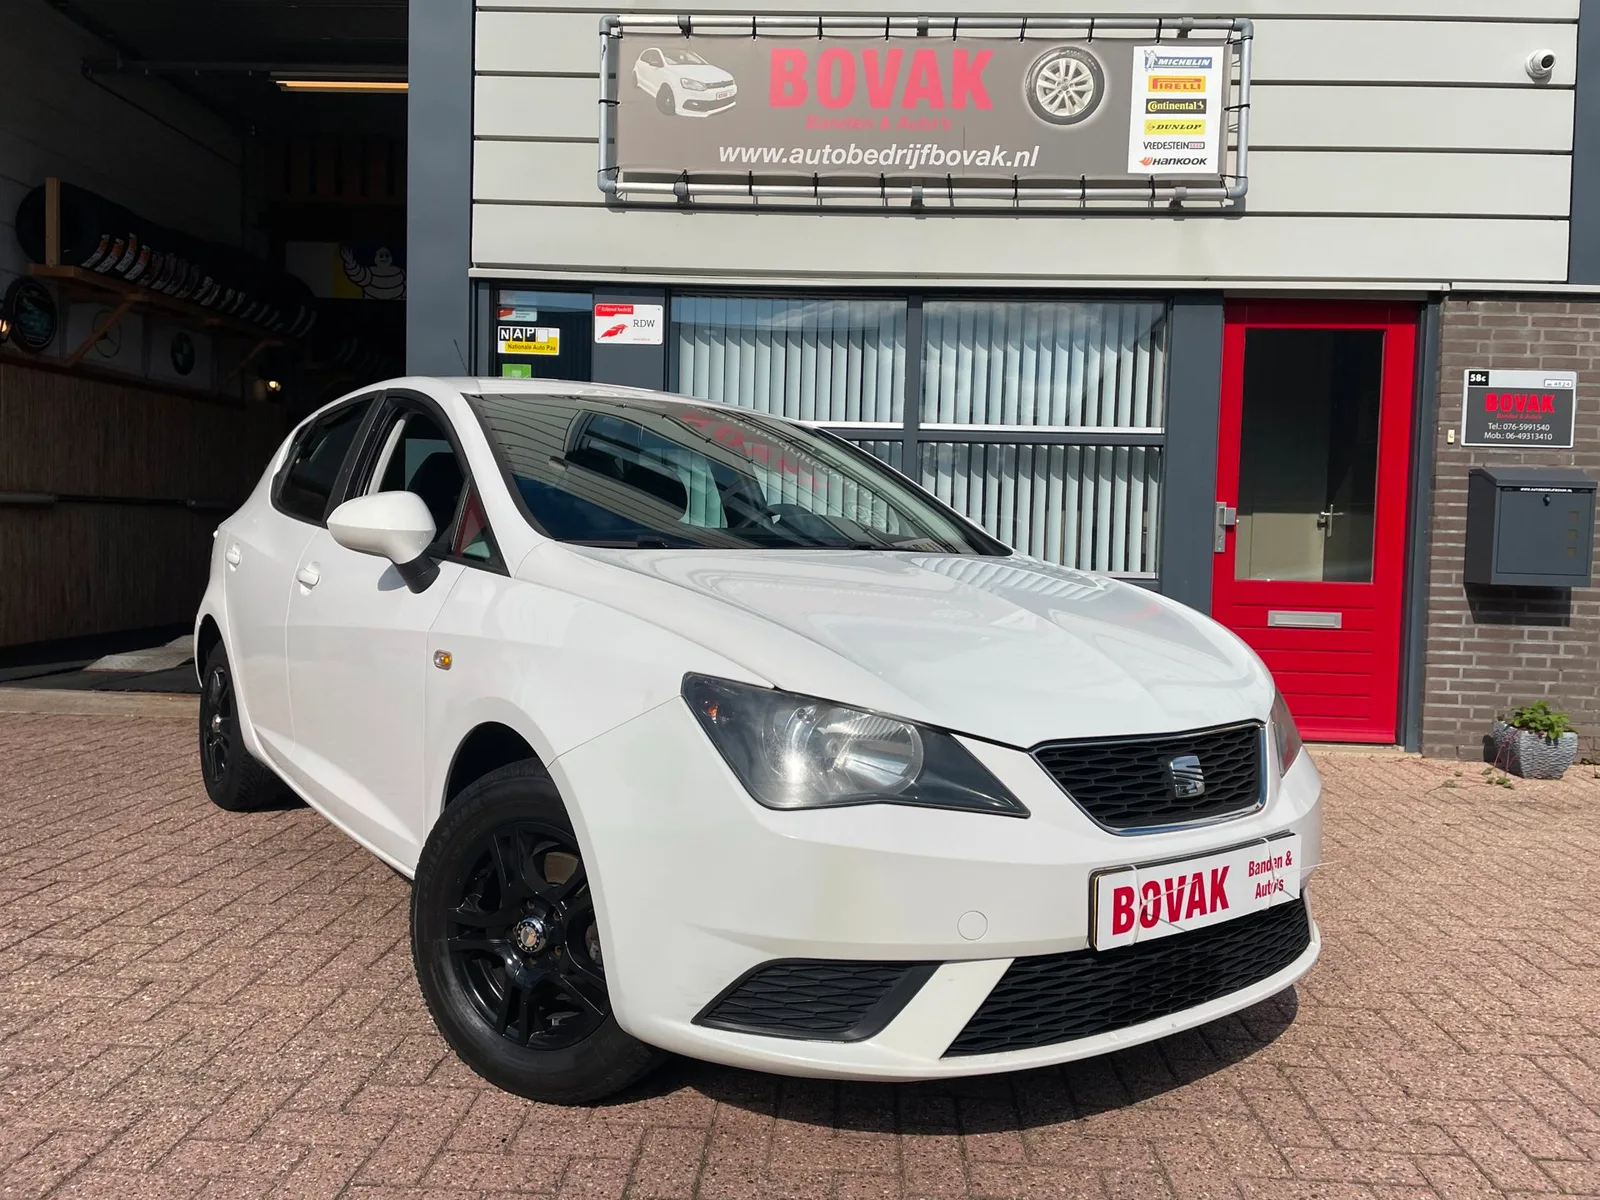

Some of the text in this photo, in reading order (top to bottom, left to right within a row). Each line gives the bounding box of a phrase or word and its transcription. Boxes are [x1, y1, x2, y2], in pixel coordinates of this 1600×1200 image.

[1157, 58, 1211, 66] MICHELIN
[769, 47, 995, 111] BOVAK
[1152, 78, 1202, 90] PIRELLI
[1147, 101, 1197, 112] Continental
[878, 115, 892, 131] &
[1143, 141, 1189, 150] VREDESTEIN
[719, 143, 1040, 170] www.autobedrijfbovak.nl
[633, 319, 656, 328] RDW
[500, 328, 535, 340] NAP
[1469, 373, 1487, 382] 58c
[1485, 392, 1556, 413] BOVAK
[1502, 423, 1551, 431] 076-5991540
[1505, 432, 1553, 441] 06-49313410
[1285, 850, 1293, 867] &
[1112, 865, 1231, 936] BOVAK
